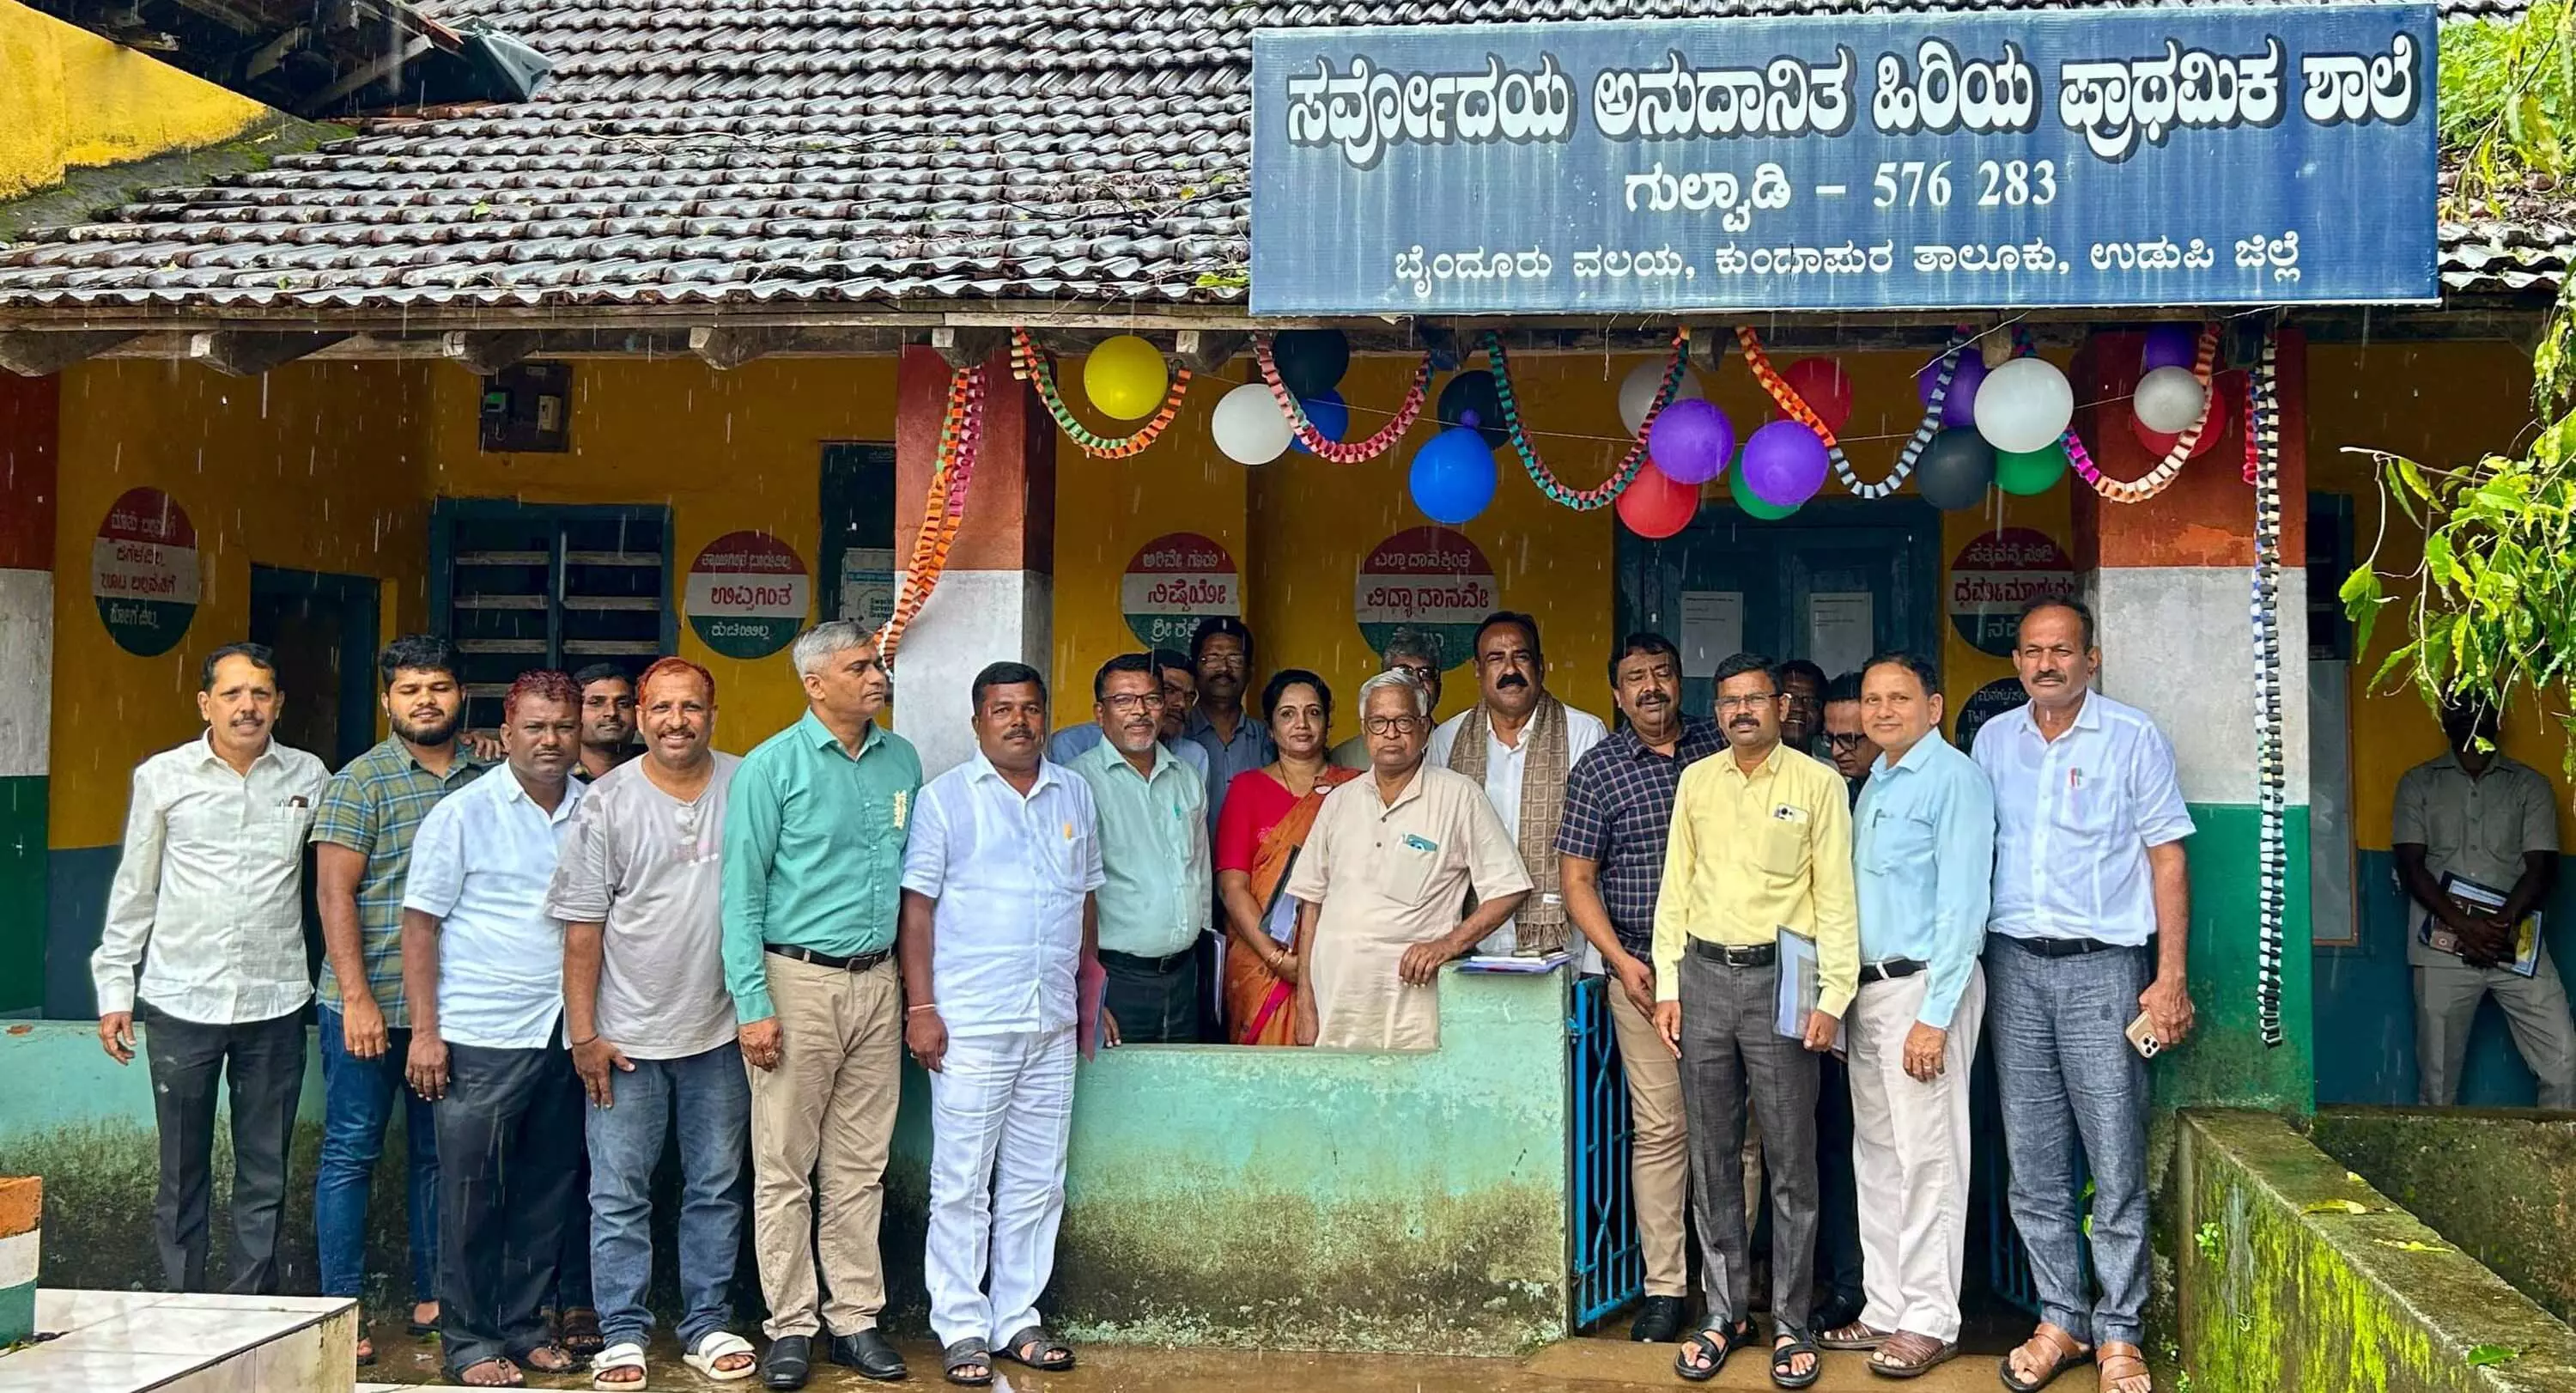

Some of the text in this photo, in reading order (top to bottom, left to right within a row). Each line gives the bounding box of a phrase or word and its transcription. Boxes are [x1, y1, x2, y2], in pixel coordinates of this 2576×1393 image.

[1289, 35, 2412, 166] ಸರ್ವೋದಯ ಅನುದಾನಿತ ಹಿರಿಯ ಪ್ರಾಥಮಿಕ ಶಾಲೆ
[1625, 161, 1792, 233] ಗುಲ್ವಾಡಿ
[1873, 161, 1952, 208] 576
[1978, 160, 2057, 207] 283
[1395, 231, 2301, 299] ಬೈಂದೂರು ವಲಯ, ಕುಂದಾಪುರ ತಾಲೂಕು, ಉಡುಪಿ ಜಿಲ್ಲೆ
